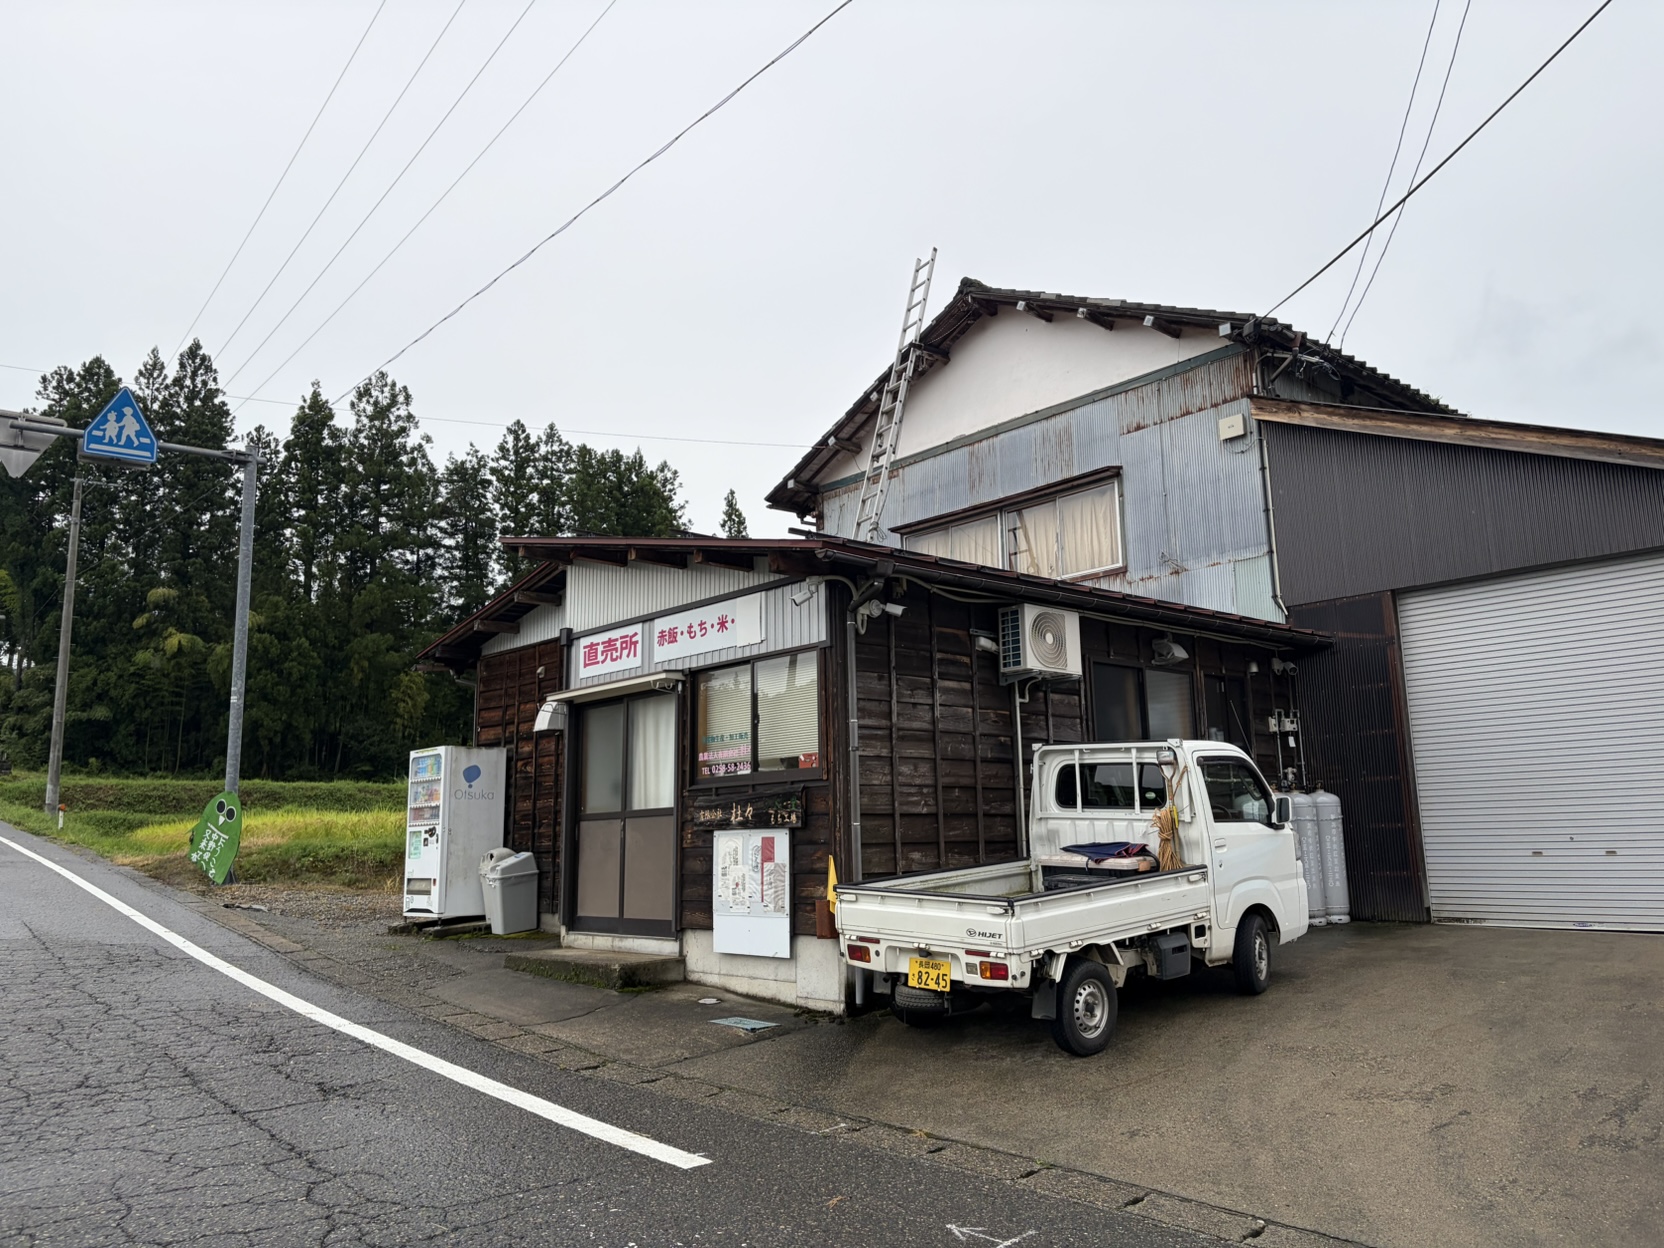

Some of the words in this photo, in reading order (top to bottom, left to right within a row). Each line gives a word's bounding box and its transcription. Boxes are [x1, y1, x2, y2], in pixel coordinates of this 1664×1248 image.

[583, 632, 639, 669] 直売所
[702, 767, 710, 775] TEL
[454, 789, 495, 801] Otsuka
[977, 931, 1003, 940] HIJET
[917, 970, 948, 989] 82-45
